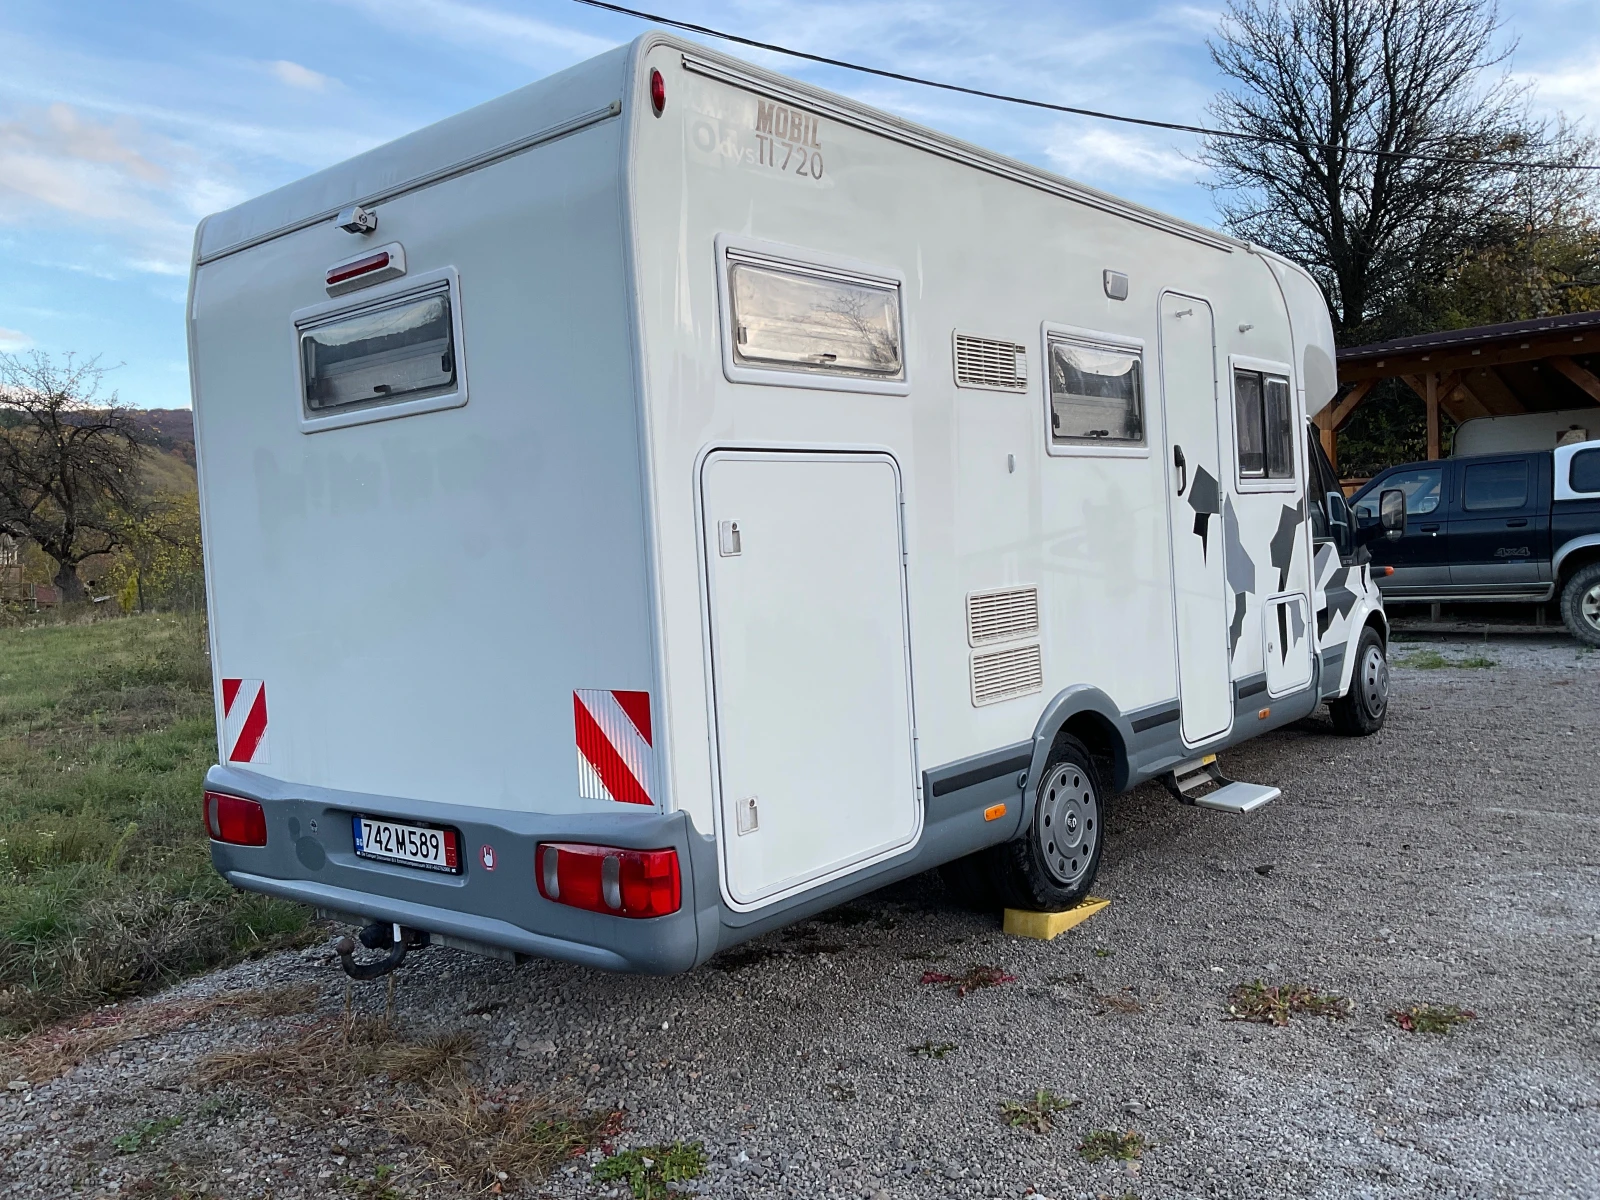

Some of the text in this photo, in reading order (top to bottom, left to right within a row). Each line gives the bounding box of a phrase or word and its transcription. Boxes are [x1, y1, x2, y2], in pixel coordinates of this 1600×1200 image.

[756, 100, 821, 150] MOBIL
[781, 141, 824, 180] 720
[363, 823, 440, 860] 742M589
